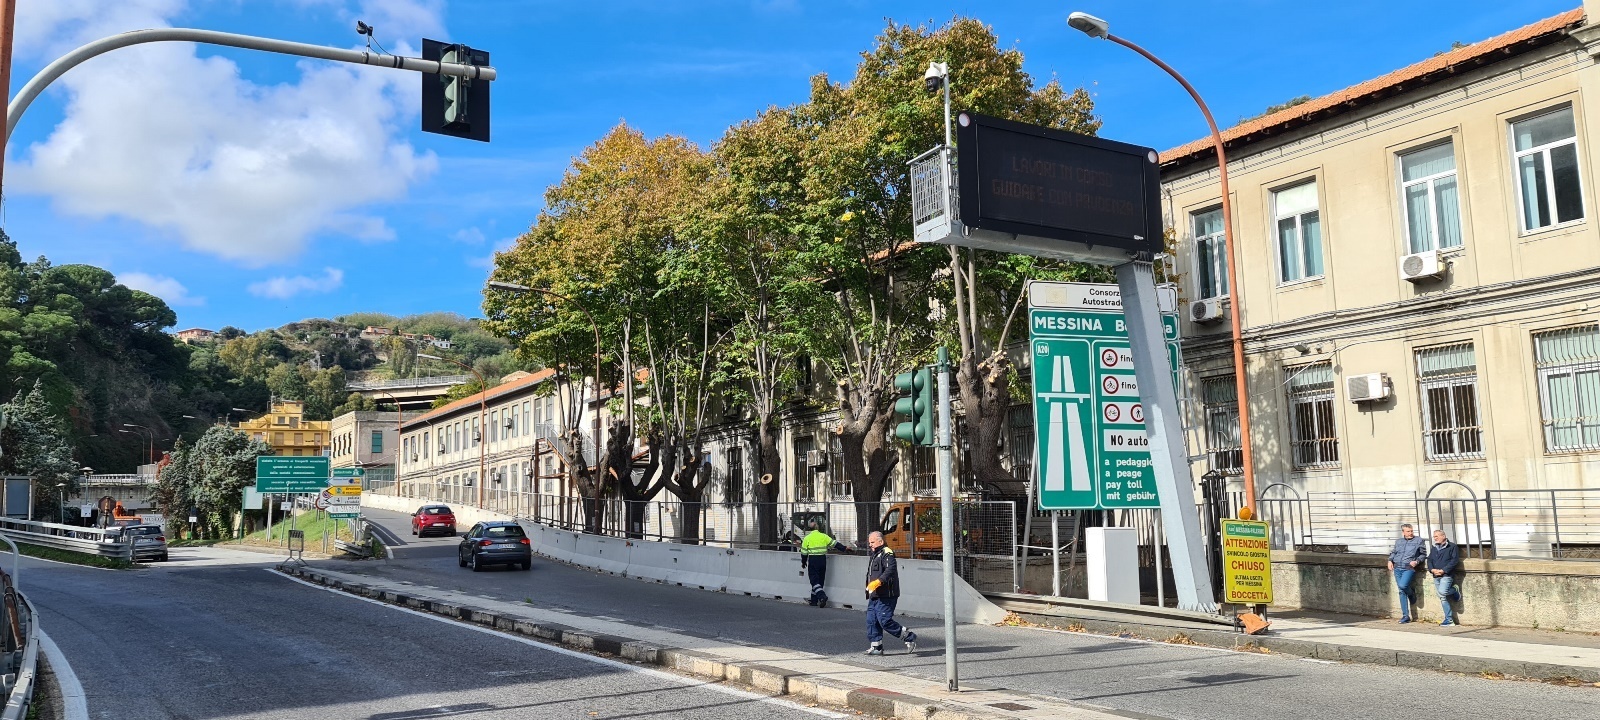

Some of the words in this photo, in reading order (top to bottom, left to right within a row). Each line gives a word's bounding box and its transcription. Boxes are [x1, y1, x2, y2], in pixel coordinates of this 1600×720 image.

[1012, 155, 1057, 177] LAVORI
[1059, 163, 1073, 181] IN
[1076, 167, 1113, 188] CORSO
[992, 178, 1044, 202] GUIDARE
[1048, 188, 1072, 206] CON
[1075, 191, 1134, 216] PRUDENZA
[1089, 288, 1121, 297] Consorz
[1034, 316, 1103, 331] MESSINA
[1037, 345, 1049, 354] A20
[1121, 381, 1137, 390] fino
[1110, 434, 1123, 446] NO
[1117, 470, 1142, 478] peage
[1105, 481, 1121, 490] pay
[1127, 480, 1142, 488] toll
[1106, 491, 1120, 500] mit
[1126, 491, 1156, 501] gebühr
[1225, 538, 1268, 550] ATTENZIONE
[1226, 550, 1249, 558] SVINCOLO
[1231, 560, 1265, 571] CHIUSO
[1231, 590, 1268, 600] BOCCETTA
